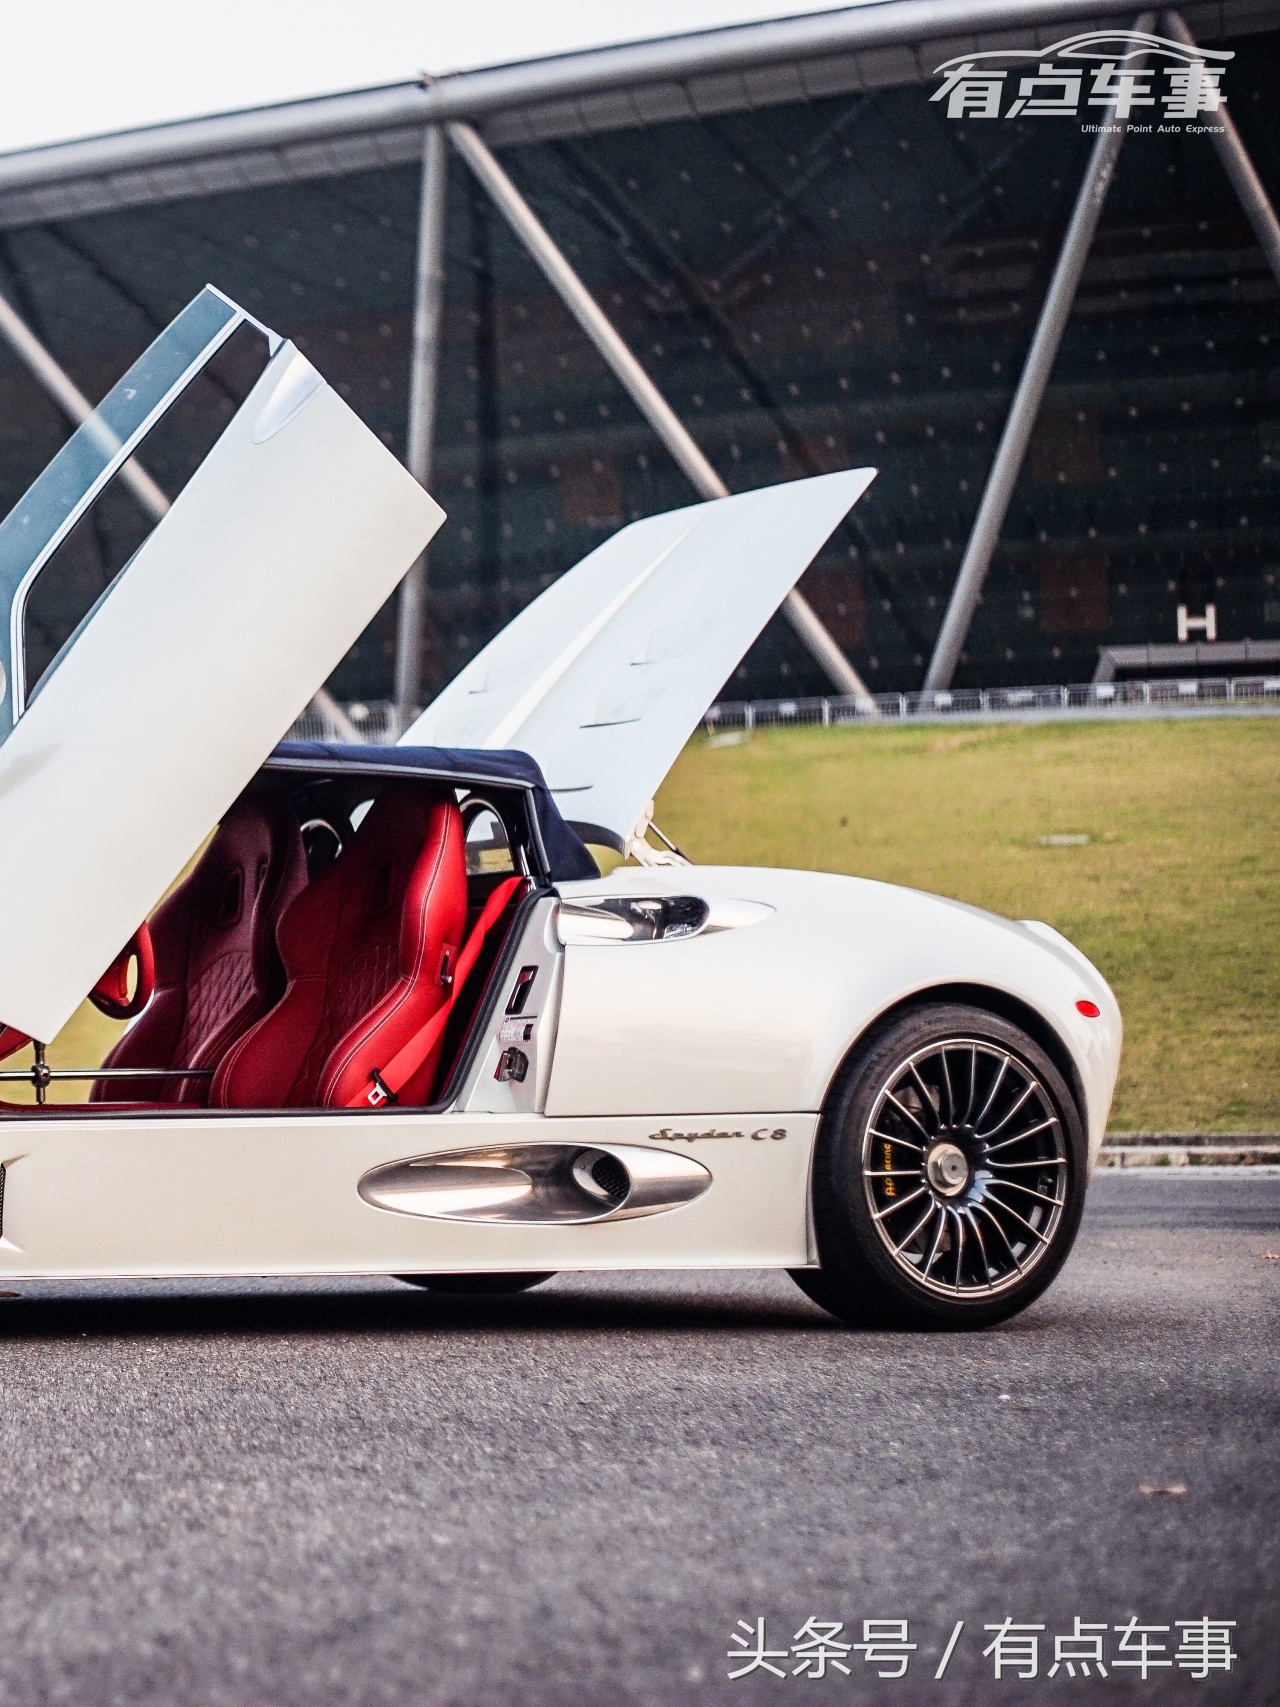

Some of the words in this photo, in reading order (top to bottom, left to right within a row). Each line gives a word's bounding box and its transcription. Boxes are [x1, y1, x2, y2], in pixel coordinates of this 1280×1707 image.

[1176, 602, 1218, 642] H
[648, 1128, 745, 1143] Spyder
[751, 1128, 788, 1141] C8
